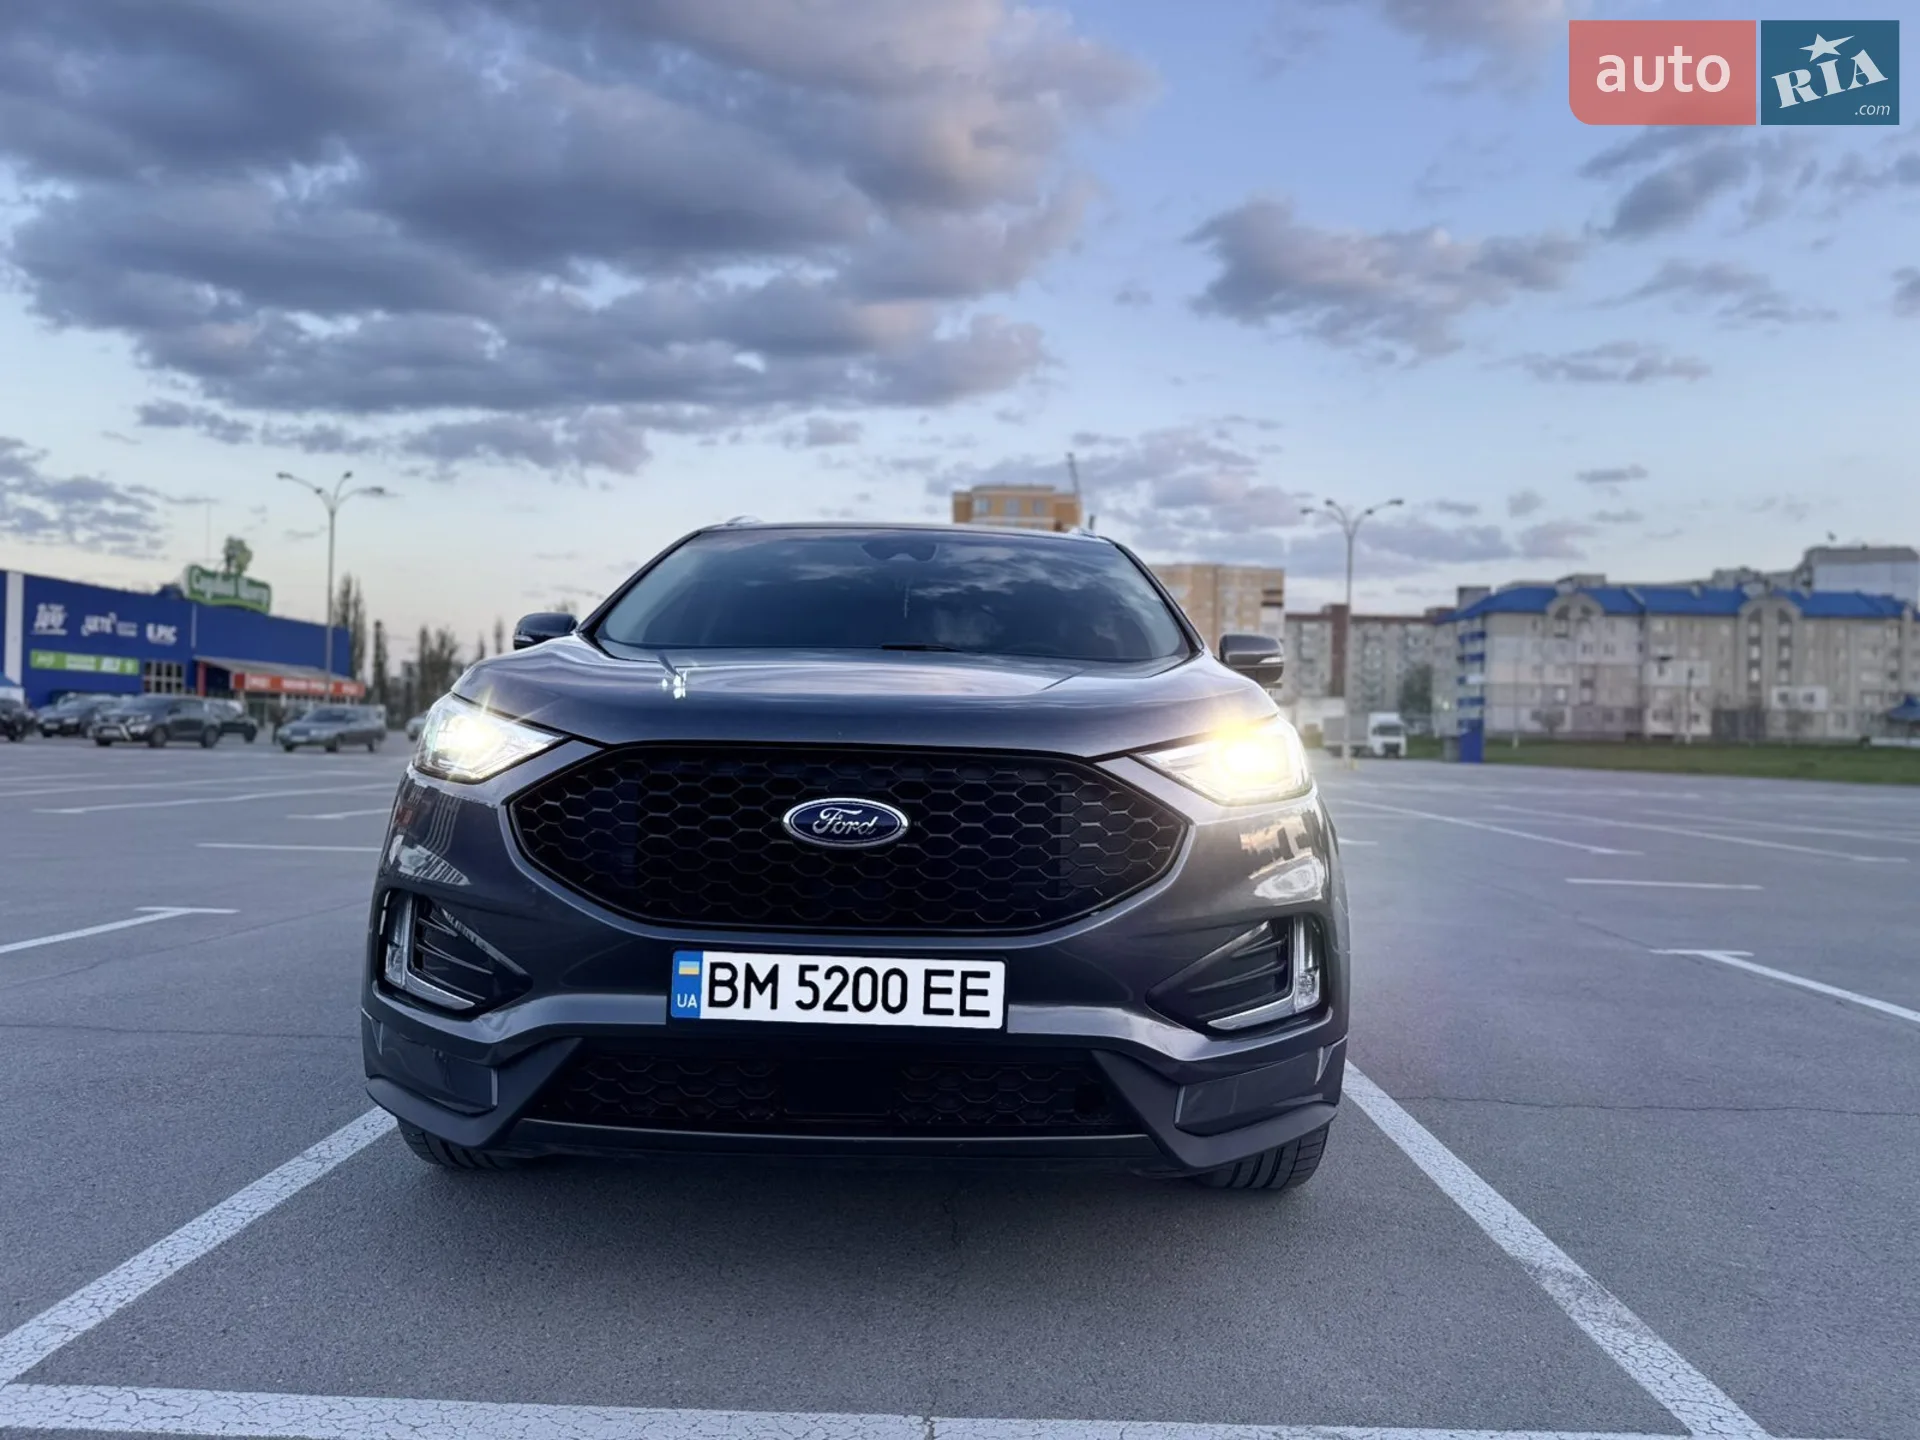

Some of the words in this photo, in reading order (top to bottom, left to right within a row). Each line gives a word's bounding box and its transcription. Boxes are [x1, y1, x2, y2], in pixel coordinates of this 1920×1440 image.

[812, 807, 880, 836] Ford
[677, 994, 698, 1009] UA
[708, 962, 779, 1010] BM
[795, 964, 908, 1014] 5200
[923, 969, 991, 1018] EE
